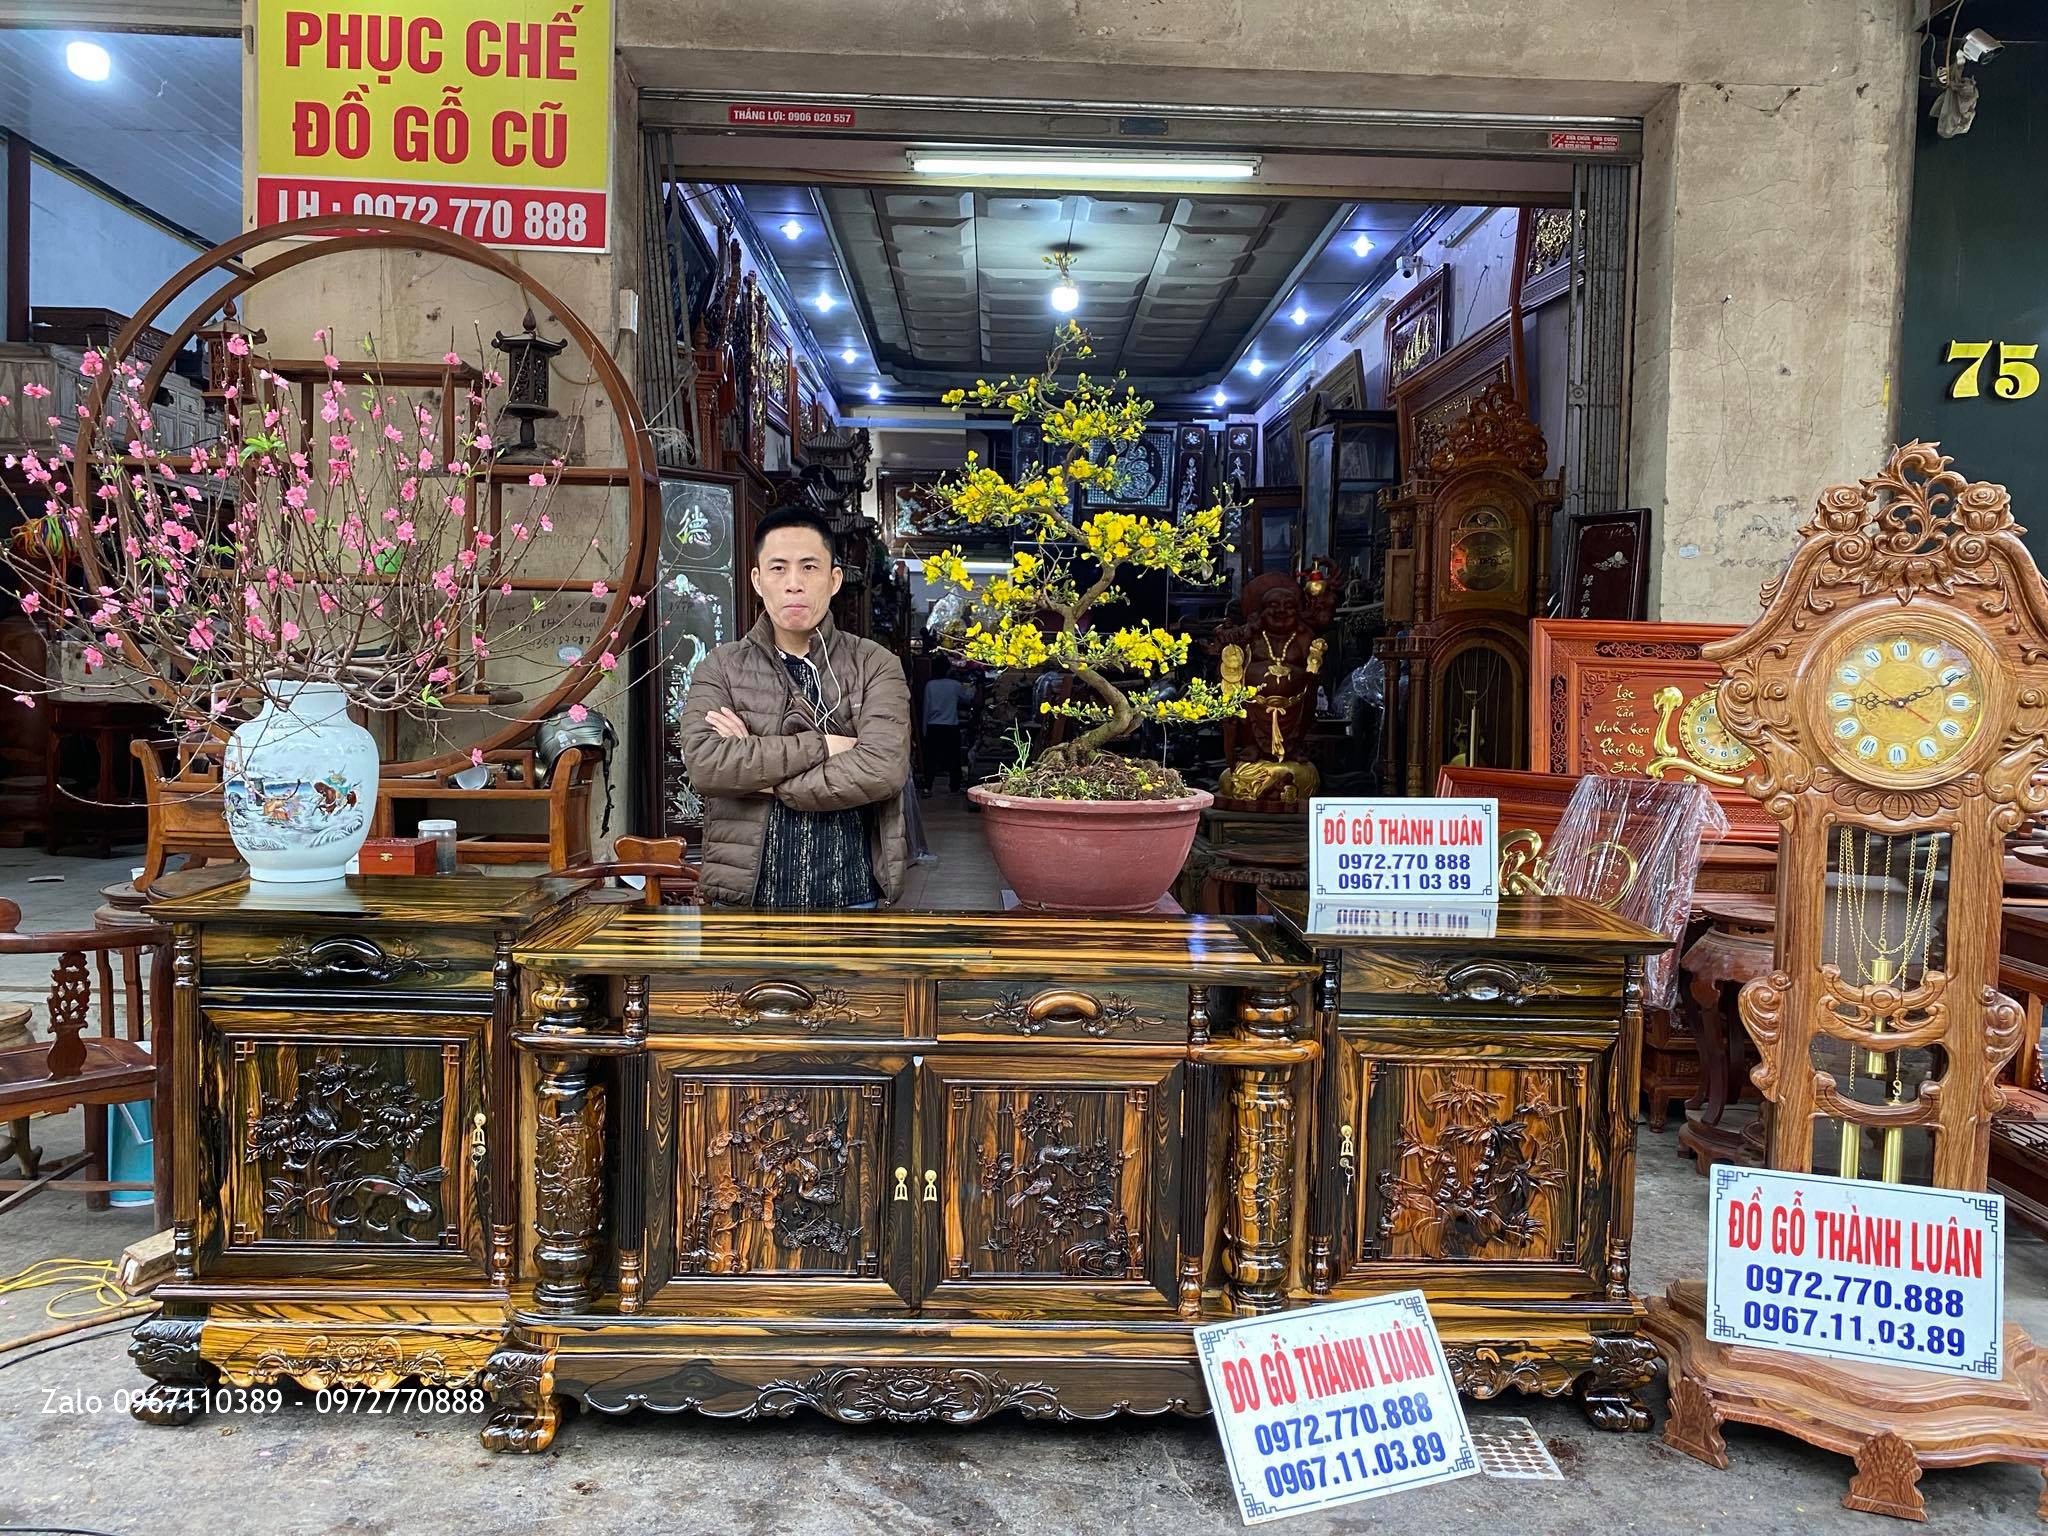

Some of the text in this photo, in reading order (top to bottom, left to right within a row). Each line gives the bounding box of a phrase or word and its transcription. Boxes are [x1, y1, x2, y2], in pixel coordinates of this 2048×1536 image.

[286, 4, 585, 85] PHỤC CHẾ
[292, 84, 568, 169] ĐỒ GỖ CŨ
[788, 112, 812, 122] 0906
[813, 113, 832, 123] 020
[833, 114, 852, 123] 557
[524, 201, 588, 242] 888
[1947, 339, 2040, 399] 75
[1324, 809, 1483, 846] ĐỒ GỖ THÀNH LUÂN
[1728, 1186, 1983, 1279] ĐỒ GỖ THÀNH LUÂN
[1745, 1264, 1965, 1318] 0972.770.888
[1743, 1301, 1966, 1357] 0967.11.03.89
[1260, 1333, 1297, 1407] GỖ
[1293, 1334, 1375, 1400] THÀNH
[1368, 1320, 1435, 1385] LUÂN
[1254, 1392, 1433, 1456] 0972.770.888
[1264, 1432, 1446, 1498] 0967.11.03.89
